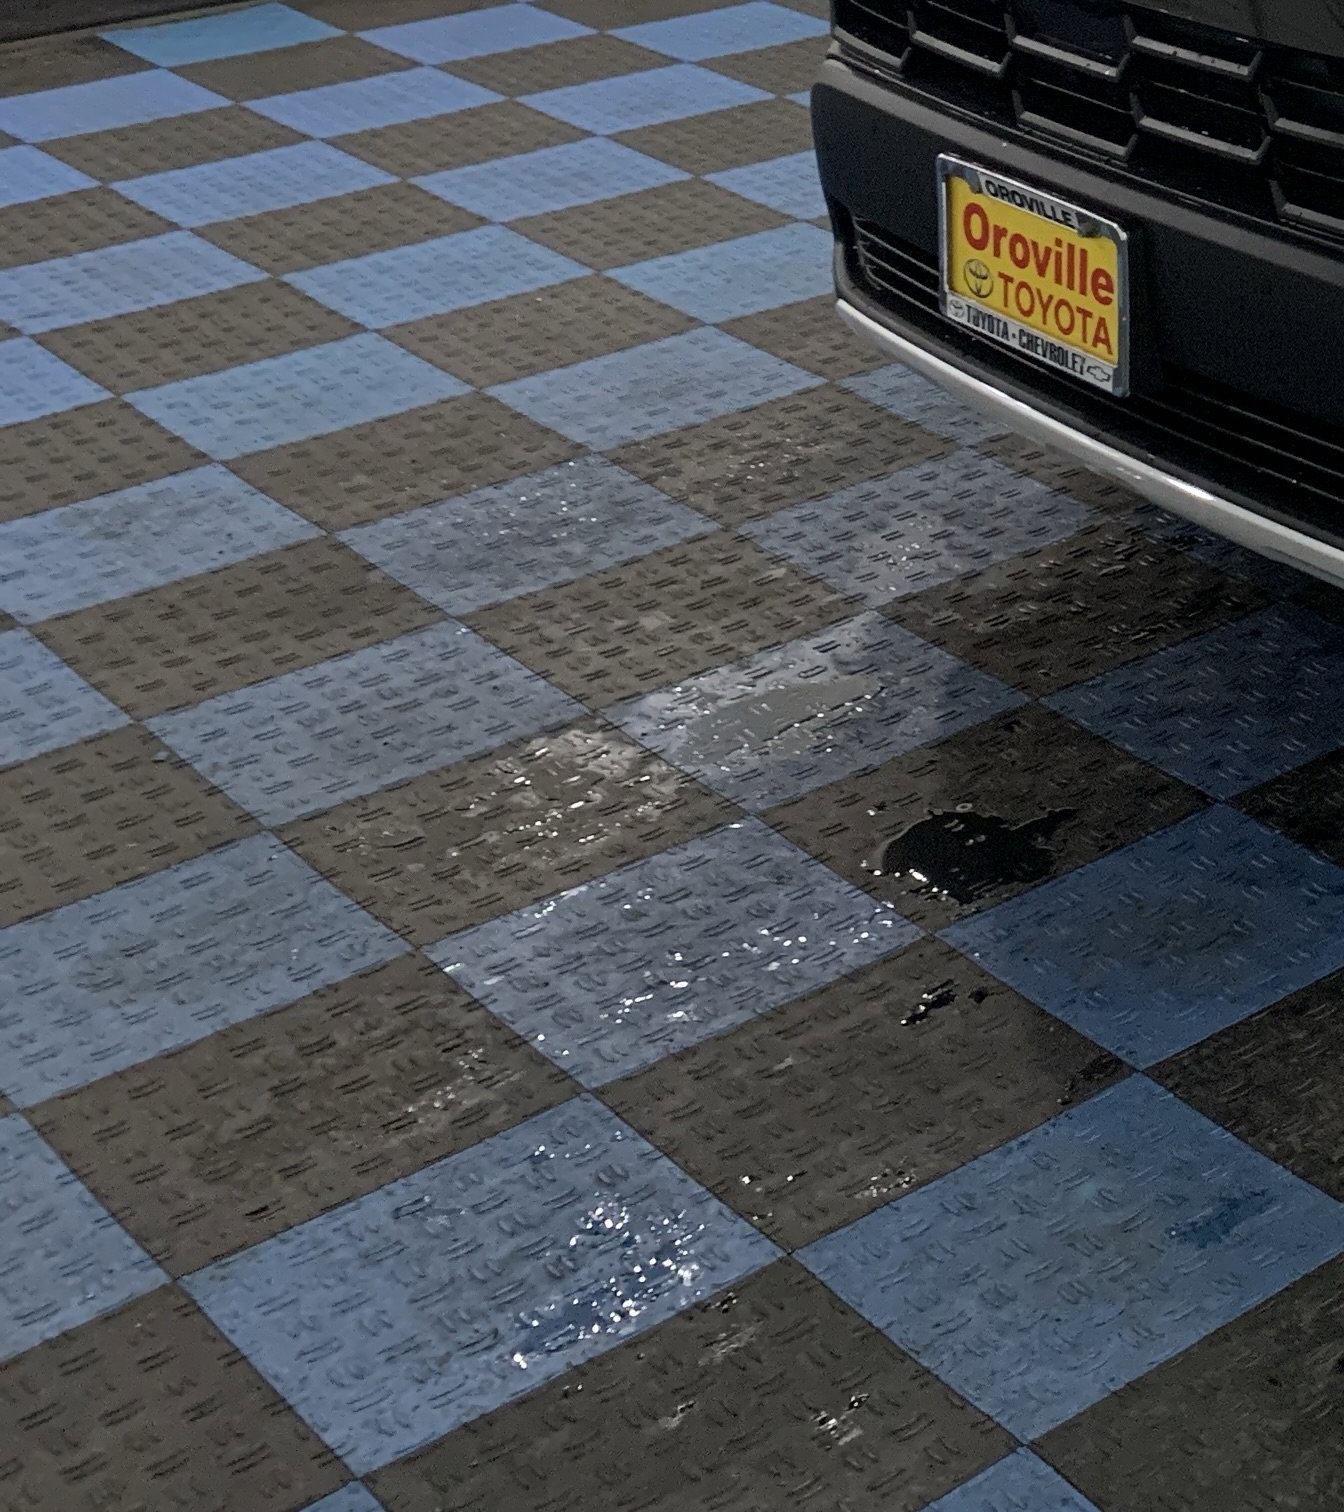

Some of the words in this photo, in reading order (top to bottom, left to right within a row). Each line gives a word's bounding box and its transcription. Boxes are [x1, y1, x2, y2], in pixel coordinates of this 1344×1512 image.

[984, 179, 1075, 230] OROVILLE
[962, 201, 1115, 307] Oroville
[965, 304, 1010, 343] TOYOTA
[1018, 328, 1087, 376] CHEVROLET
[997, 271, 1114, 356] TOYOTA
